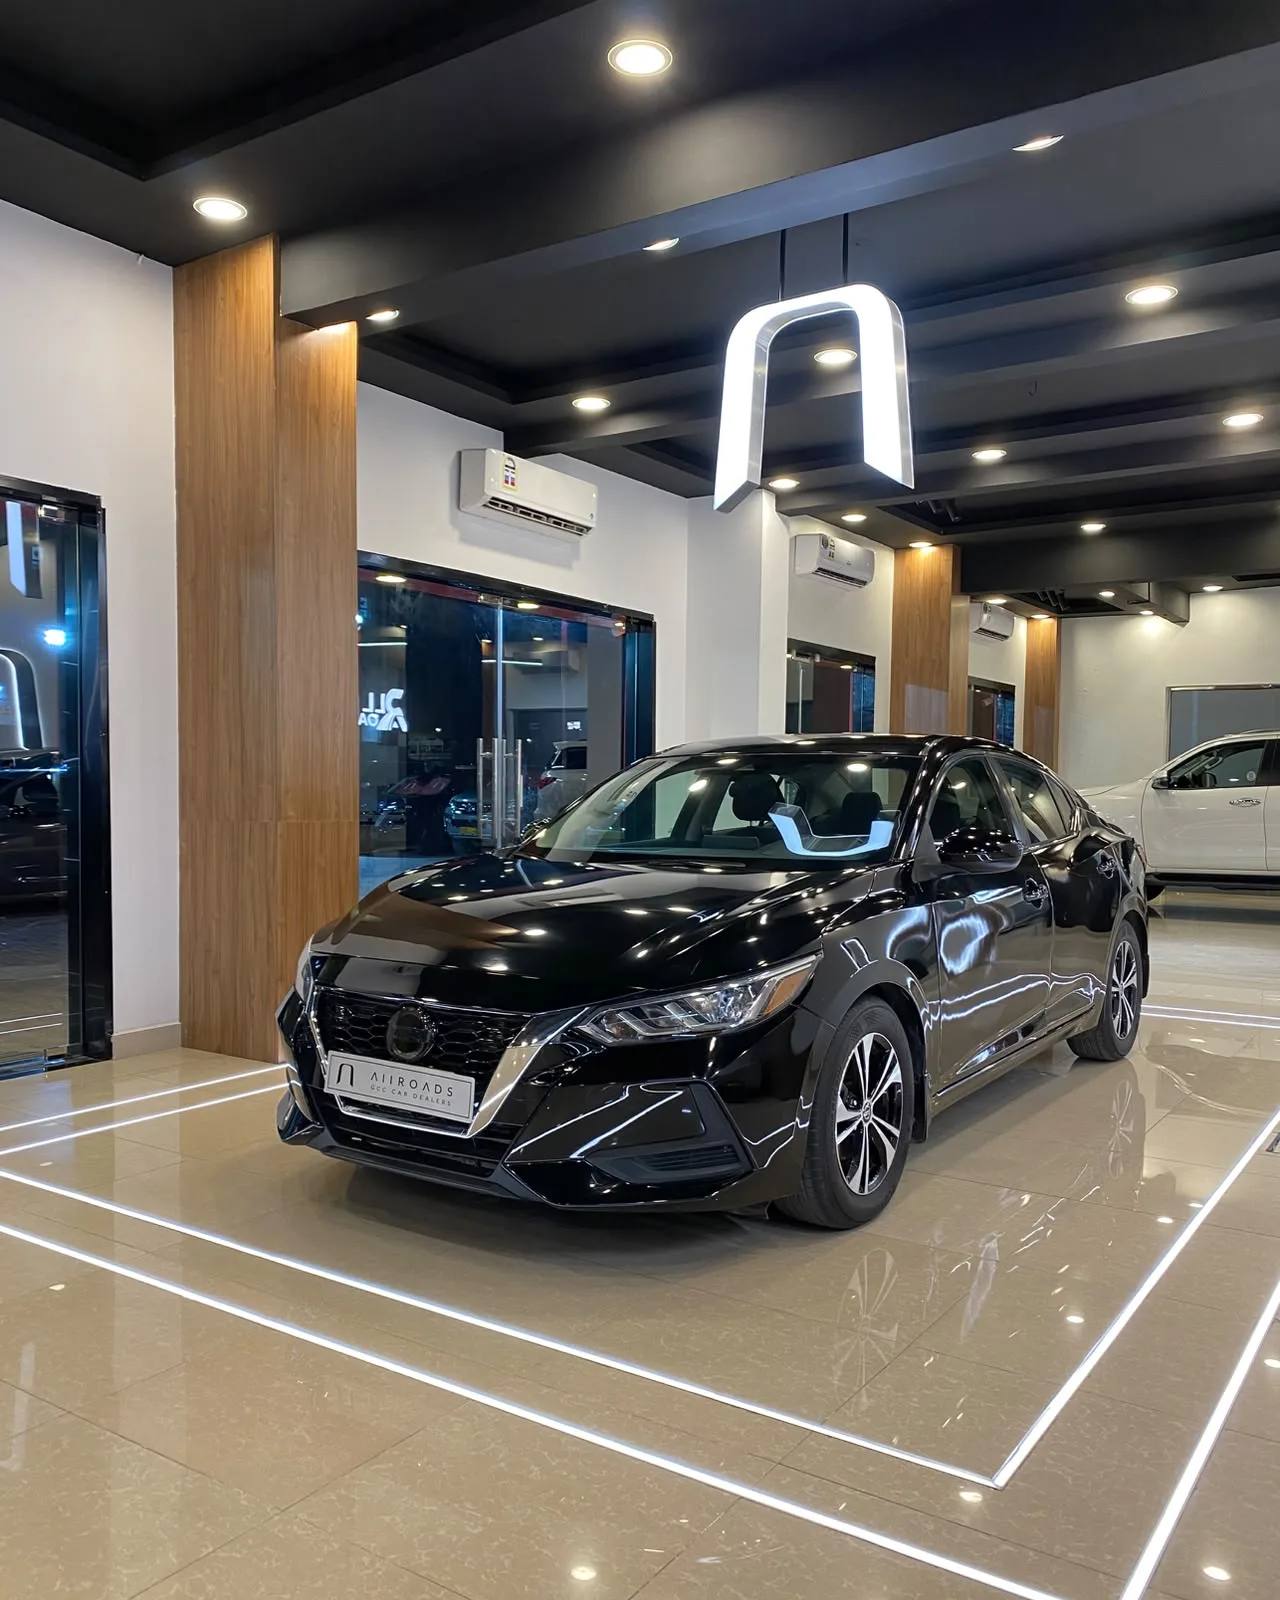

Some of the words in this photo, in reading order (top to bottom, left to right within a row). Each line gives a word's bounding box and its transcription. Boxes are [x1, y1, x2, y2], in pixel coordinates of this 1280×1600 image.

[370, 1085, 386, 1093] GCC
[391, 1089, 408, 1097] CAR
[413, 1093, 451, 1106] DEALERS
